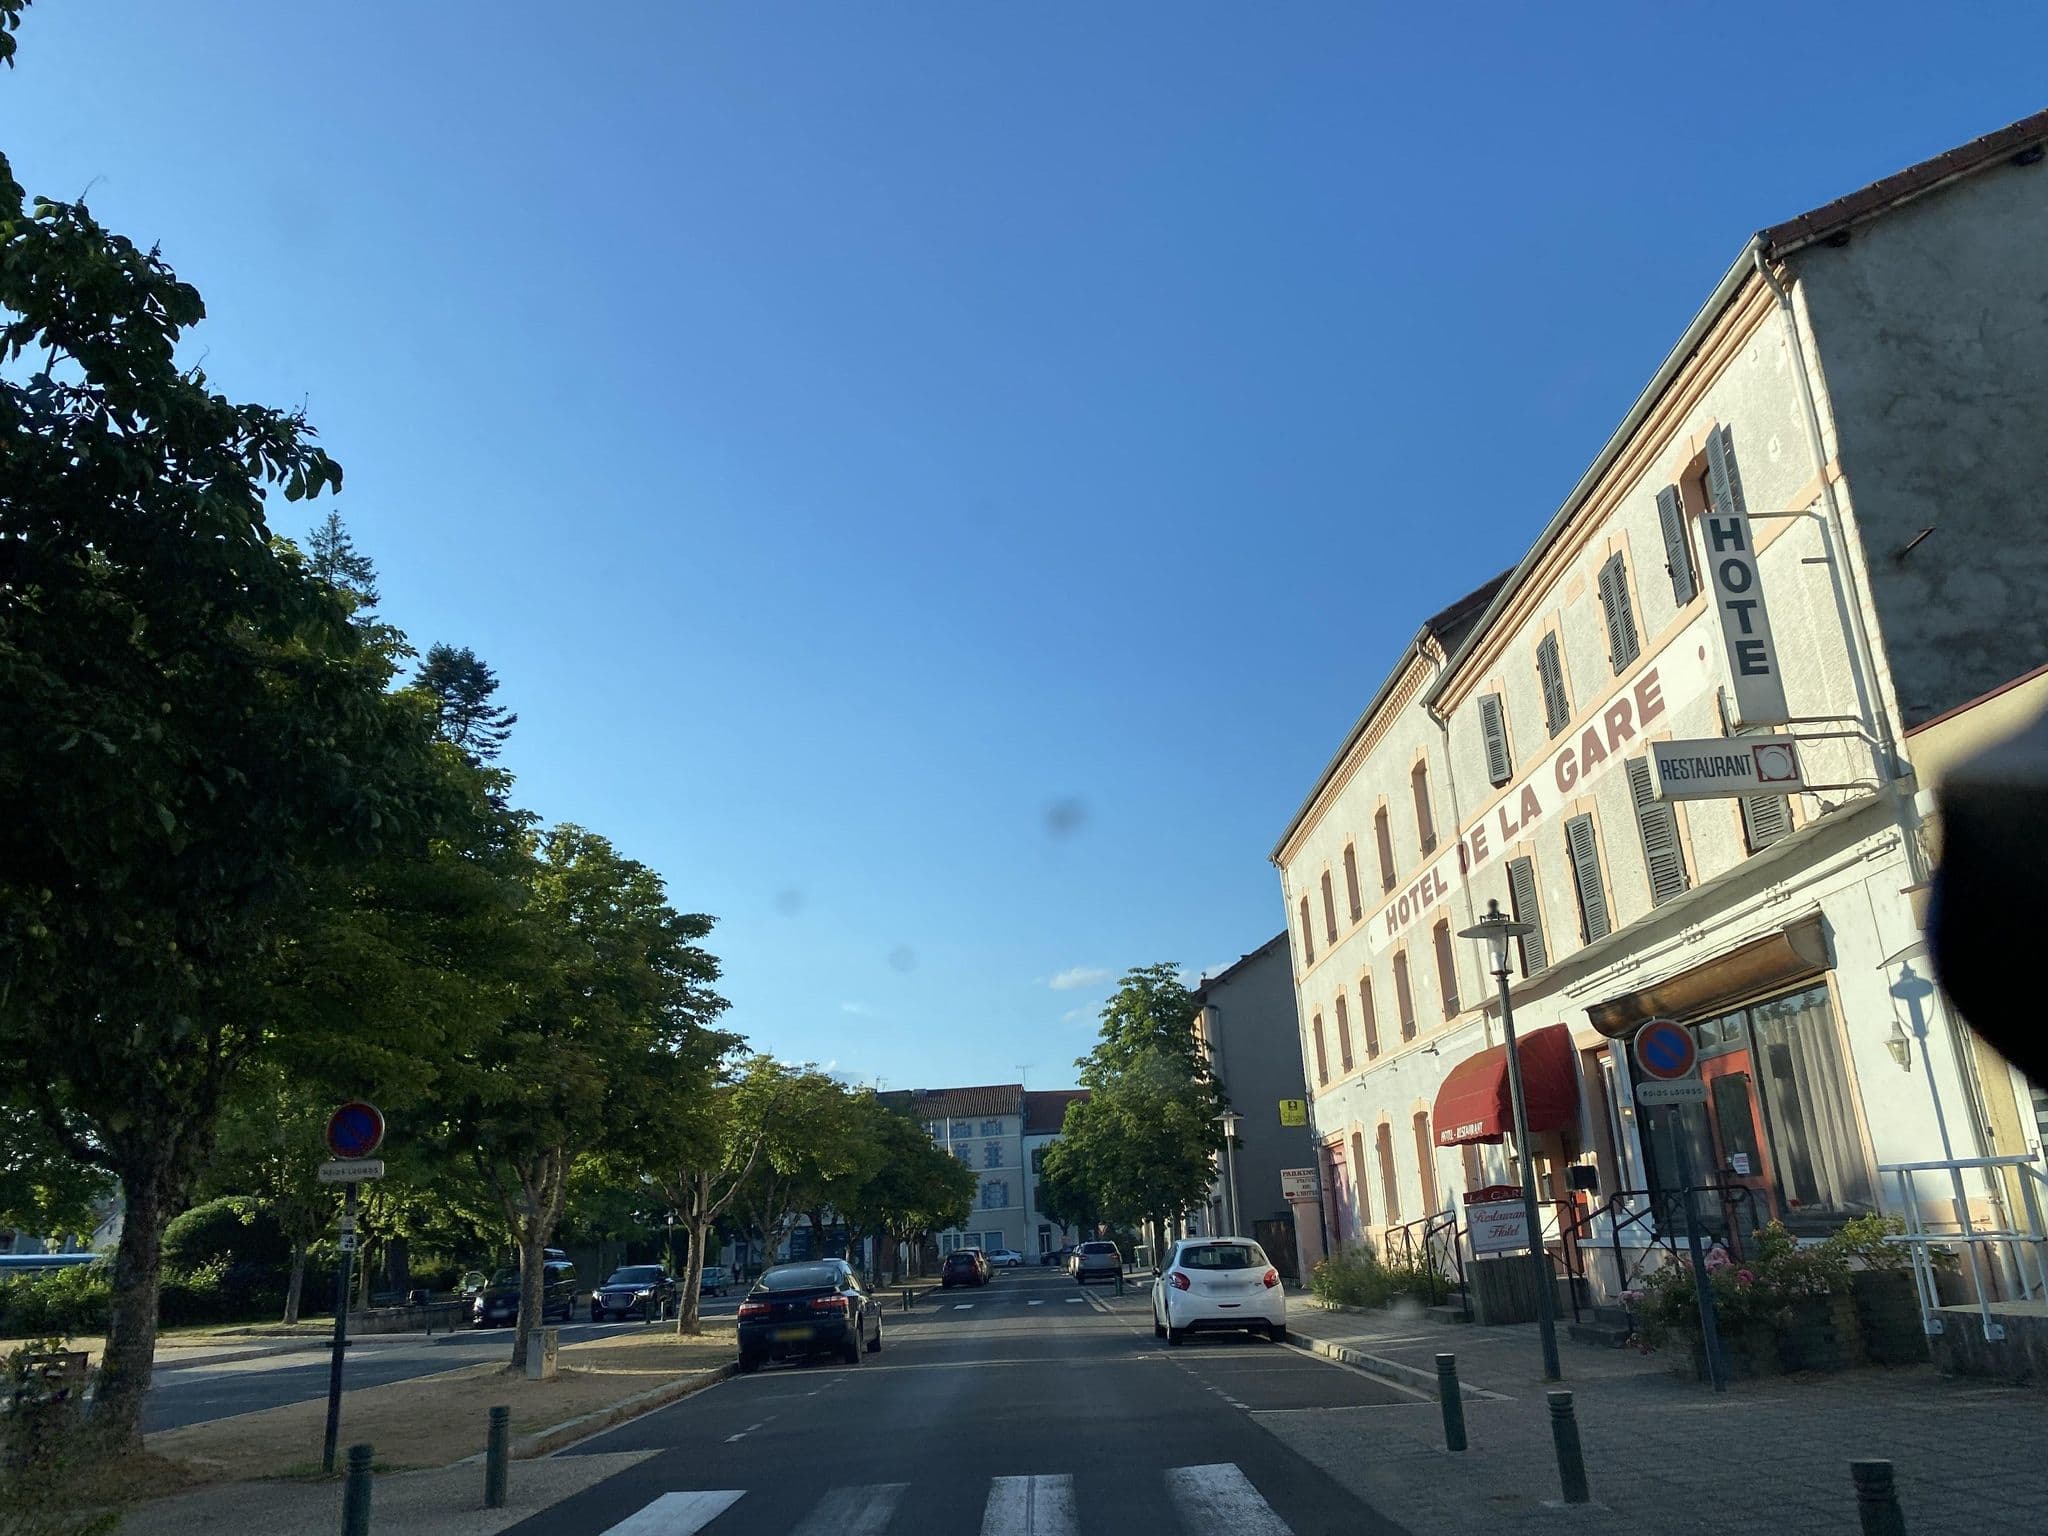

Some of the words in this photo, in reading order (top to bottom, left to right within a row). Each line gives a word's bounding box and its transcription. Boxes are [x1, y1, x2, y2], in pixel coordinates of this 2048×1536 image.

[1709, 517, 1770, 676] HOTE
[1660, 754, 1752, 780] RESTAURANT
[1385, 866, 1448, 936] HOTEL
[1456, 823, 1489, 875] DE
[1499, 784, 1542, 843] LA
[1554, 667, 1665, 793] GARE
[1490, 1188, 1523, 1200] GAR
[1472, 1209, 1527, 1224] Restauran
